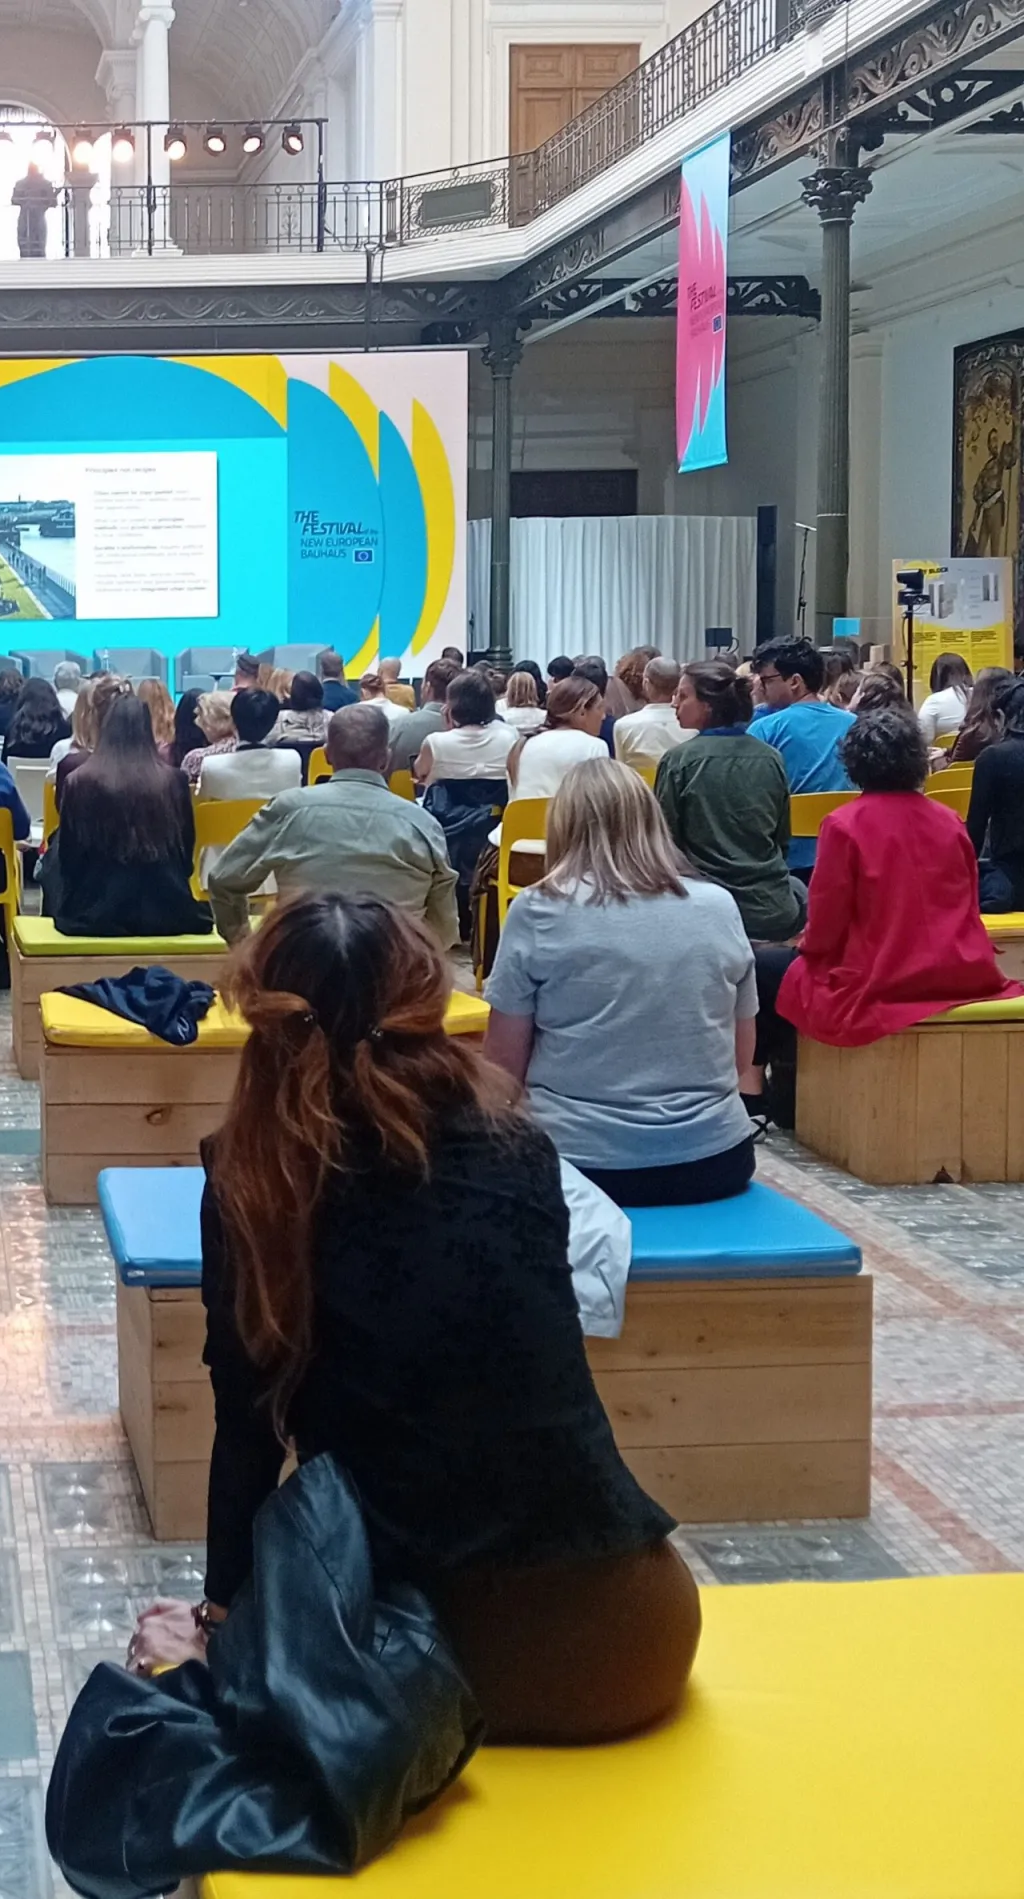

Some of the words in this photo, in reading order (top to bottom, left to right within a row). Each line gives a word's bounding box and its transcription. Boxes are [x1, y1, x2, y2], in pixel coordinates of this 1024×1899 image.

[294, 510, 319, 523] THE
[302, 522, 363, 535] FESTIVAL
[301, 538, 323, 548] NEW
[326, 537, 378, 547] EUROPEAN
[301, 549, 347, 559] BAUHAUS
